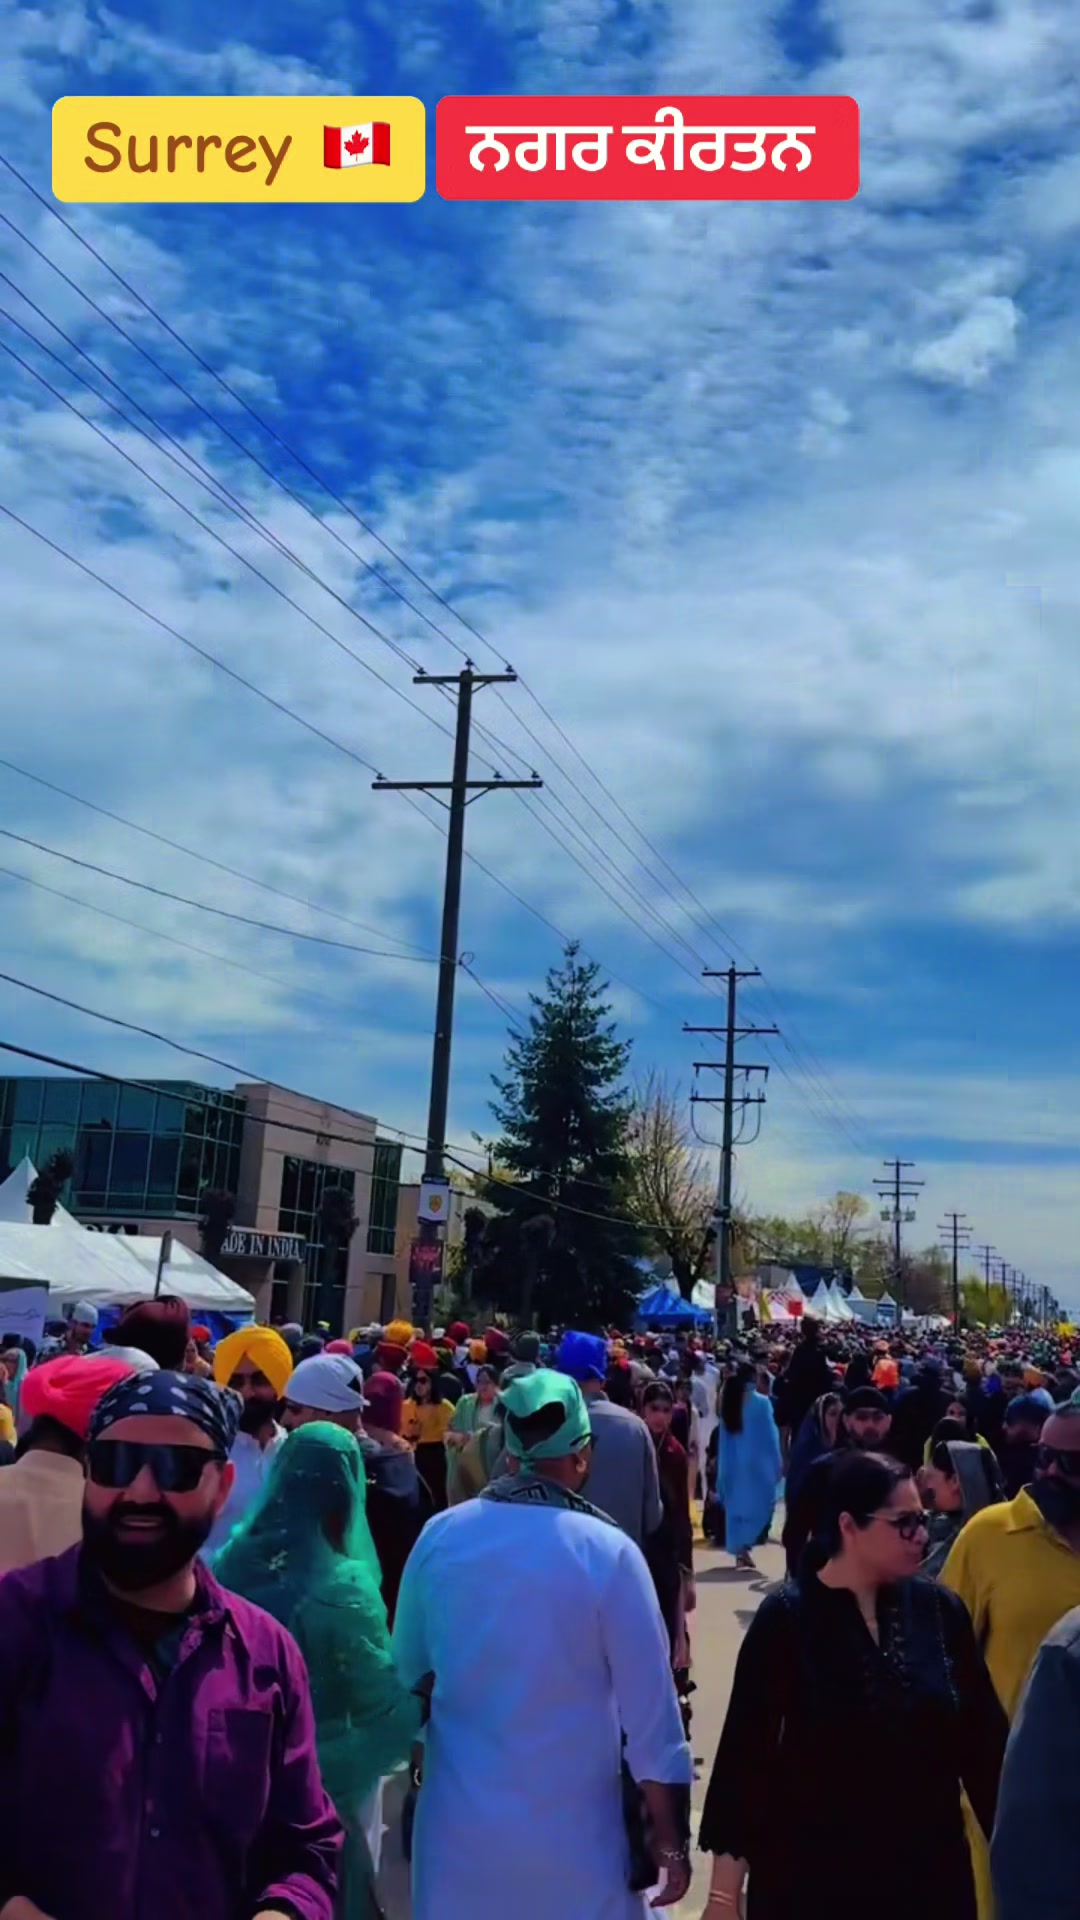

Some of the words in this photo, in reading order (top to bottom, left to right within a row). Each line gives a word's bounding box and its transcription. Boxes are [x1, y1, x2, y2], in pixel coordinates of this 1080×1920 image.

[220, 1231, 247, 1254] ADE
[250, 1233, 264, 1256] IN
[267, 1235, 301, 1259] INDIA
